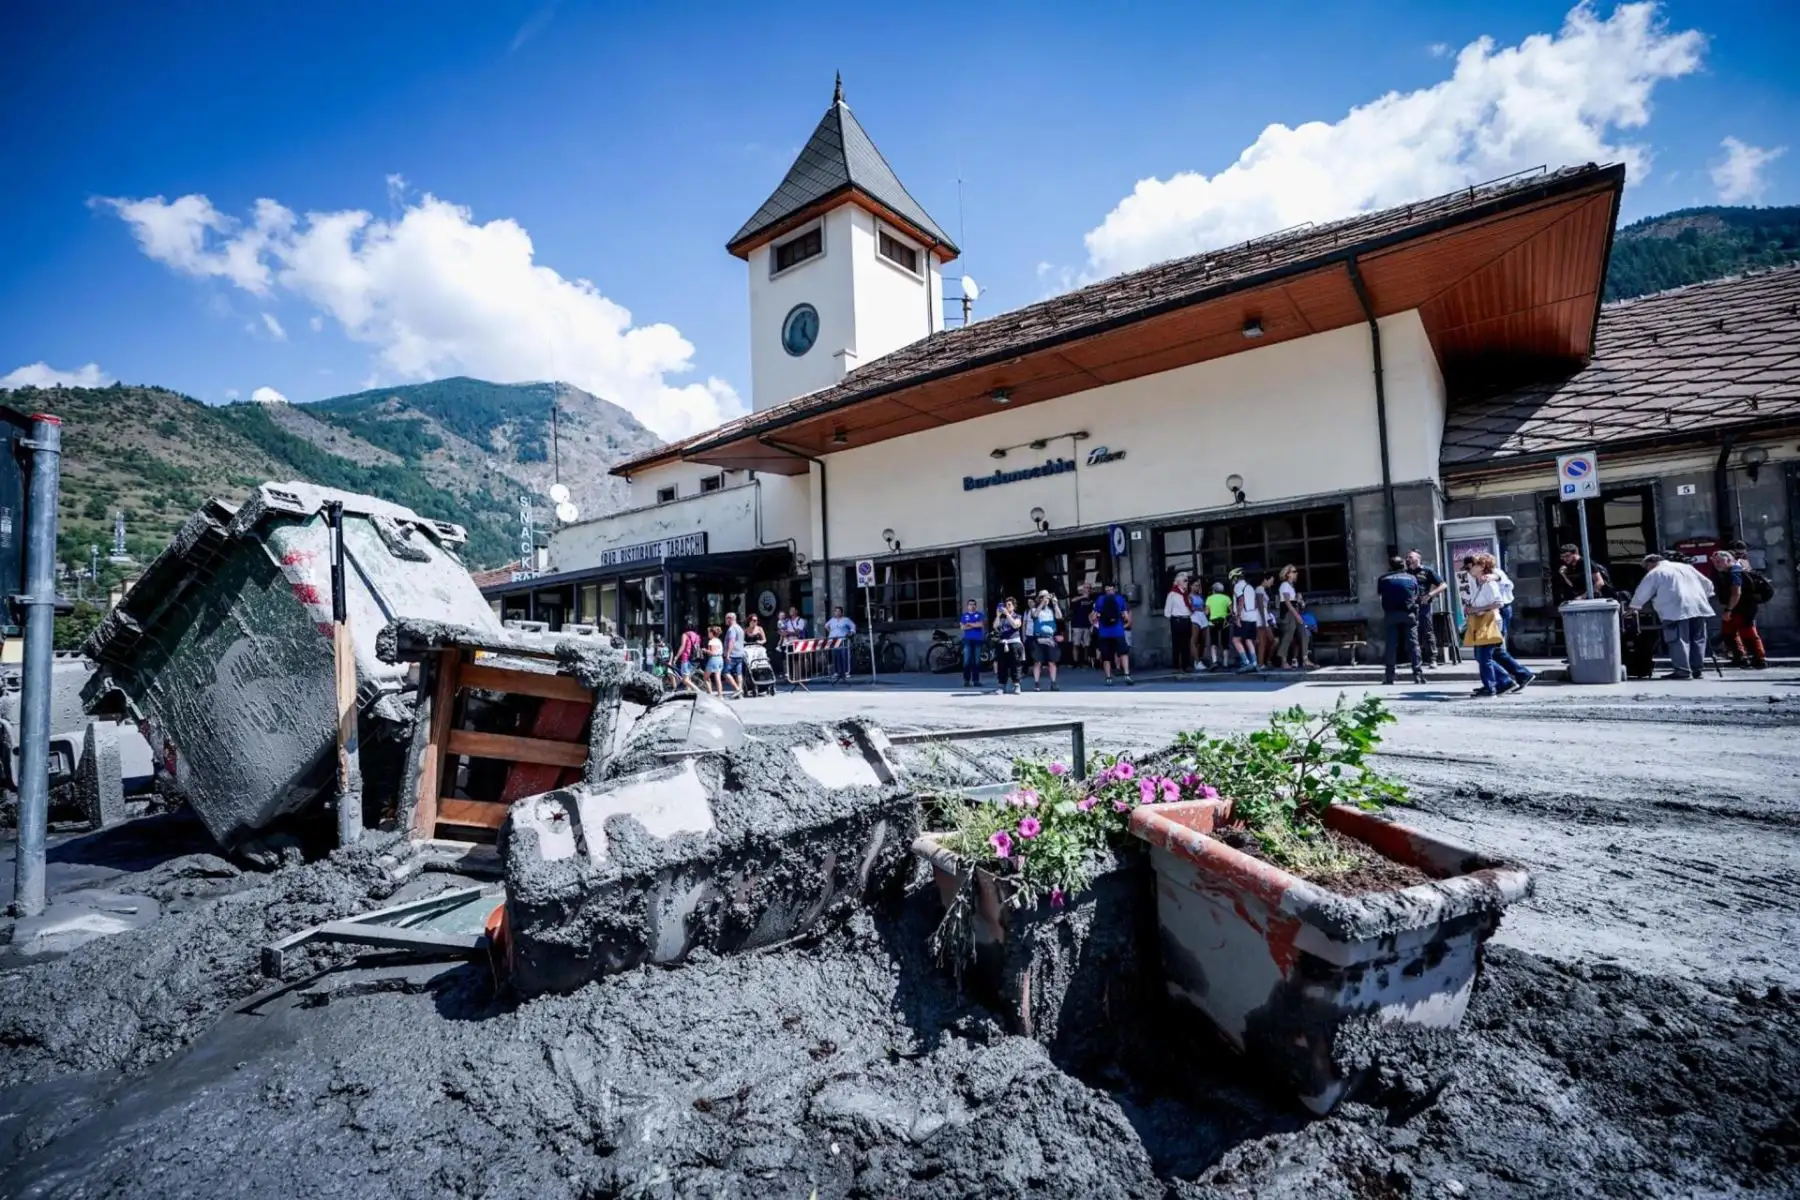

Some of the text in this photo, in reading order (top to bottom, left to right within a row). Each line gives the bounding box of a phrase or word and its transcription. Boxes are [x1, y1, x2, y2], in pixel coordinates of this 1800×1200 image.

[519, 496, 531, 569] SNACK
[621, 543, 662, 563] RISTORANTE
[667, 533, 704, 558] TABACCHI
